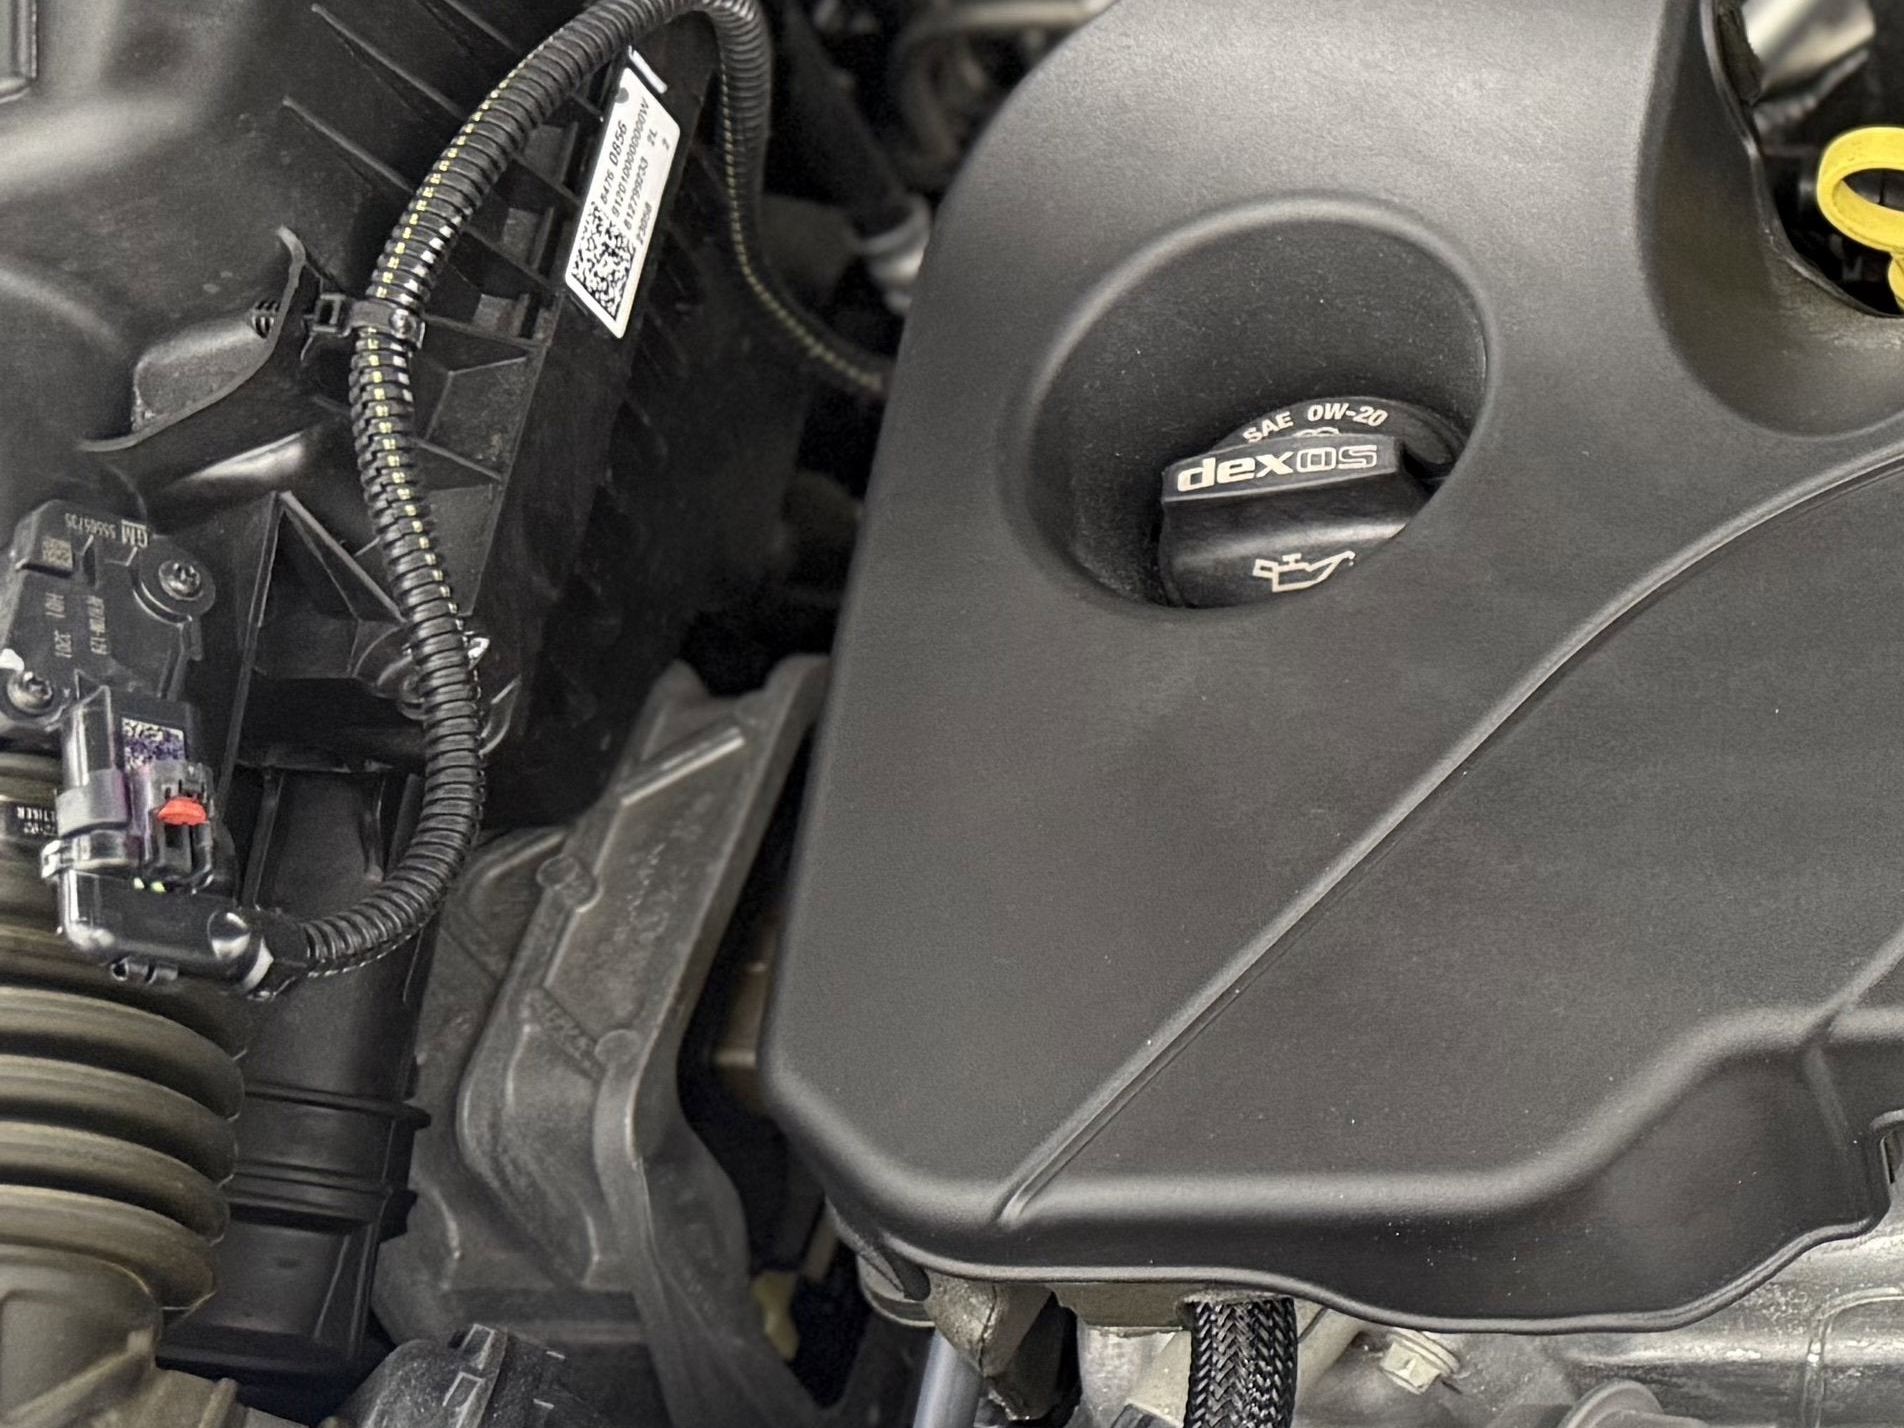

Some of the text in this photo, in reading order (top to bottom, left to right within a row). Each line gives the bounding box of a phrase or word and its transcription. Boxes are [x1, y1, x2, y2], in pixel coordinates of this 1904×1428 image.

[608, 120, 628, 167] 0856
[1243, 402, 1389, 444] SAE 0W-20
[1177, 444, 1379, 492] dexos
[121, 519, 148, 547] GM
